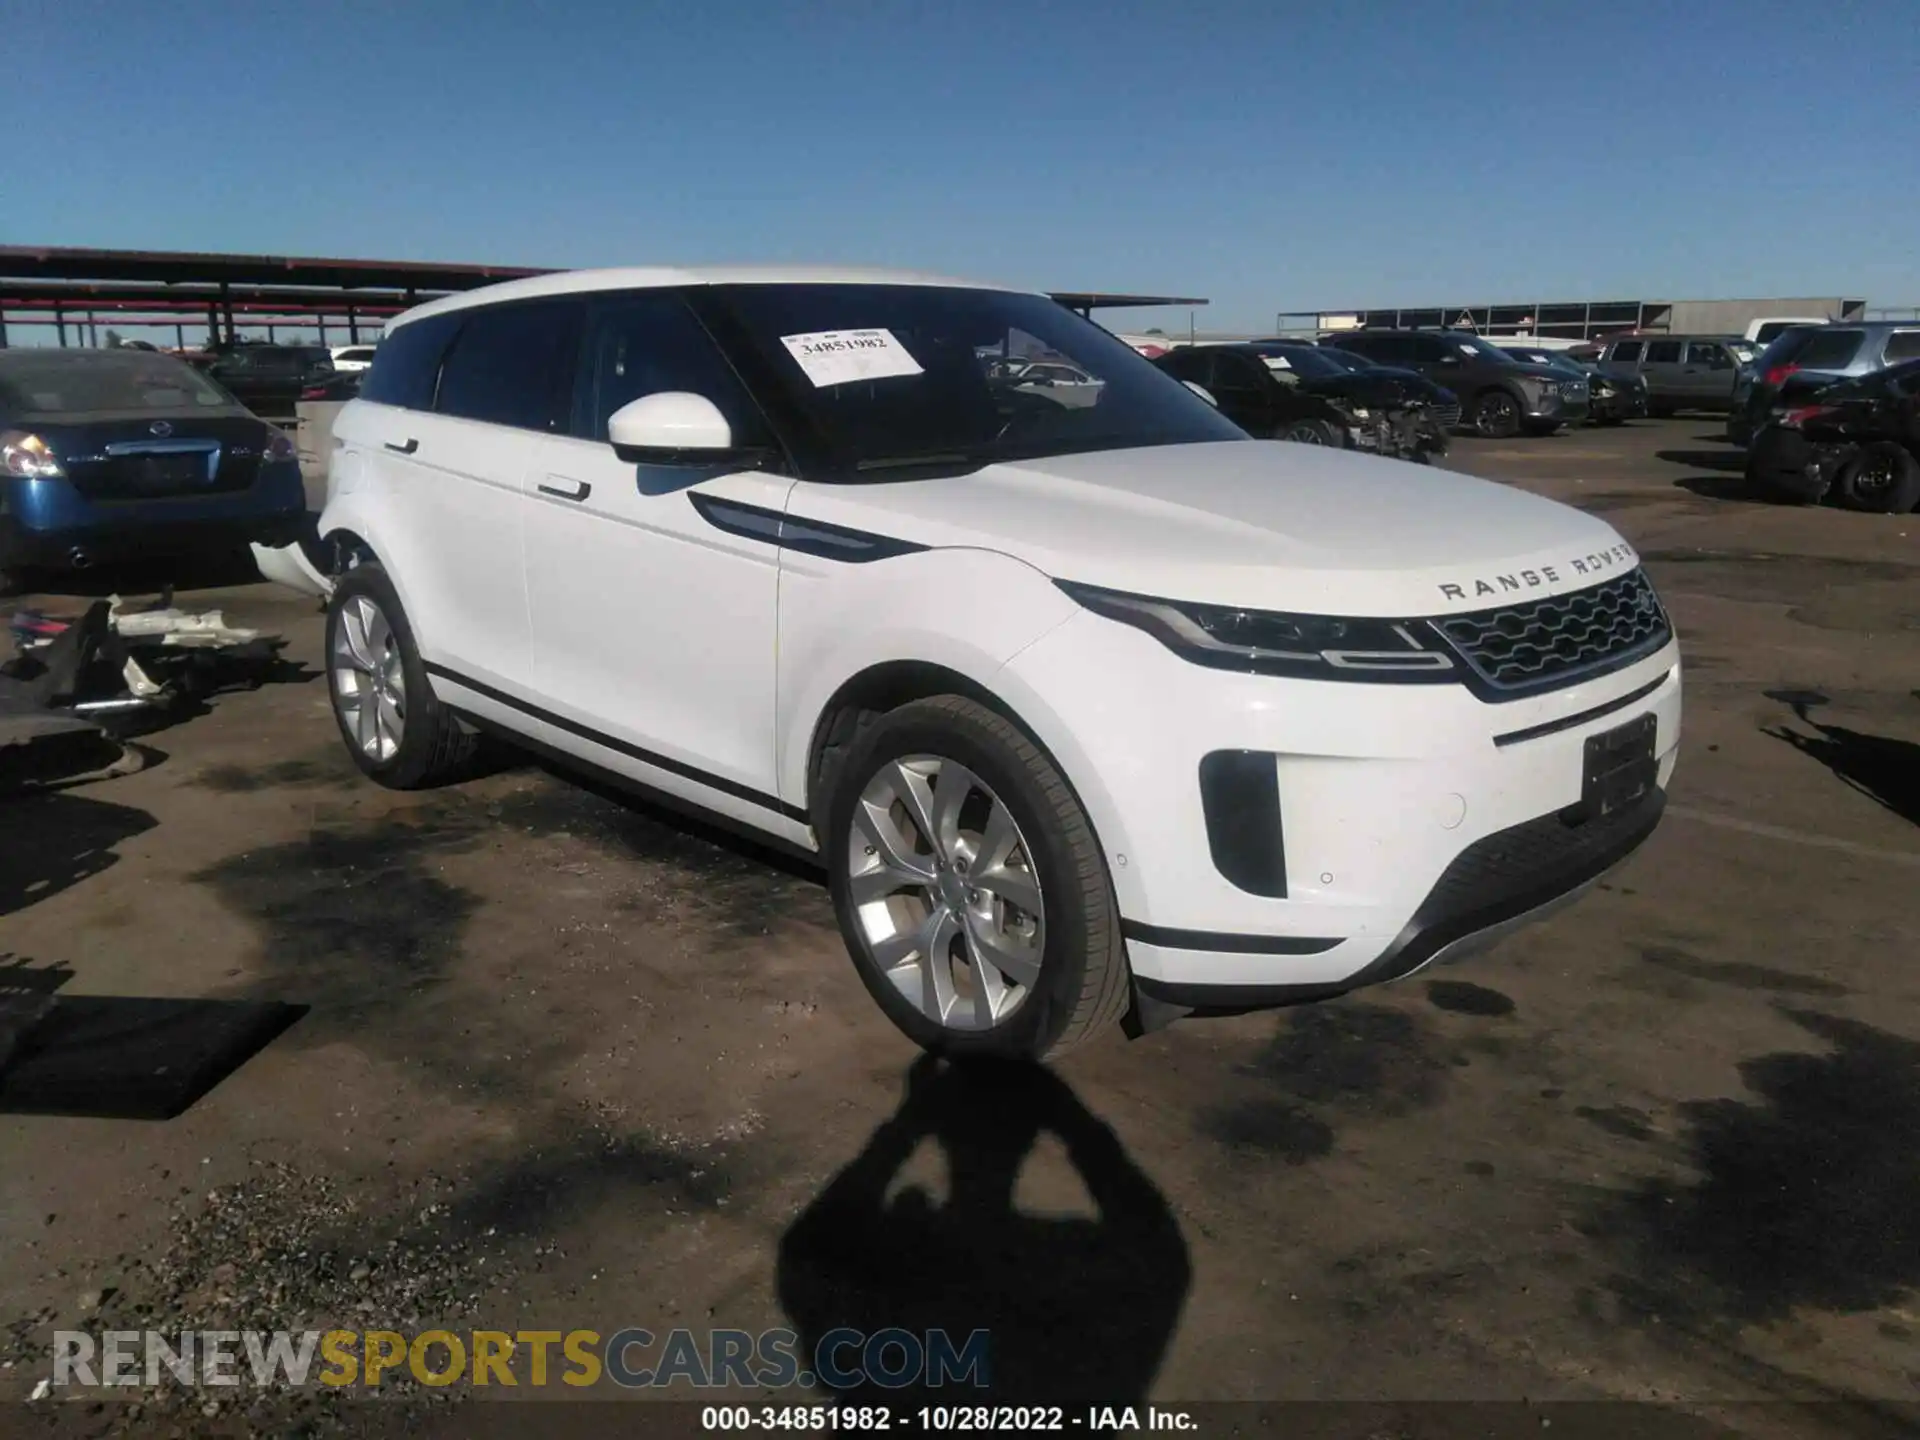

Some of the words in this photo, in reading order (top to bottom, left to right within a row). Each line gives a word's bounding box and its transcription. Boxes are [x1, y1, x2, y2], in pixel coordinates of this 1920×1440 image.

[802, 338, 887, 355] 34851982
[1438, 567, 1560, 600] RANGE
[1570, 544, 1633, 574] ROVER
